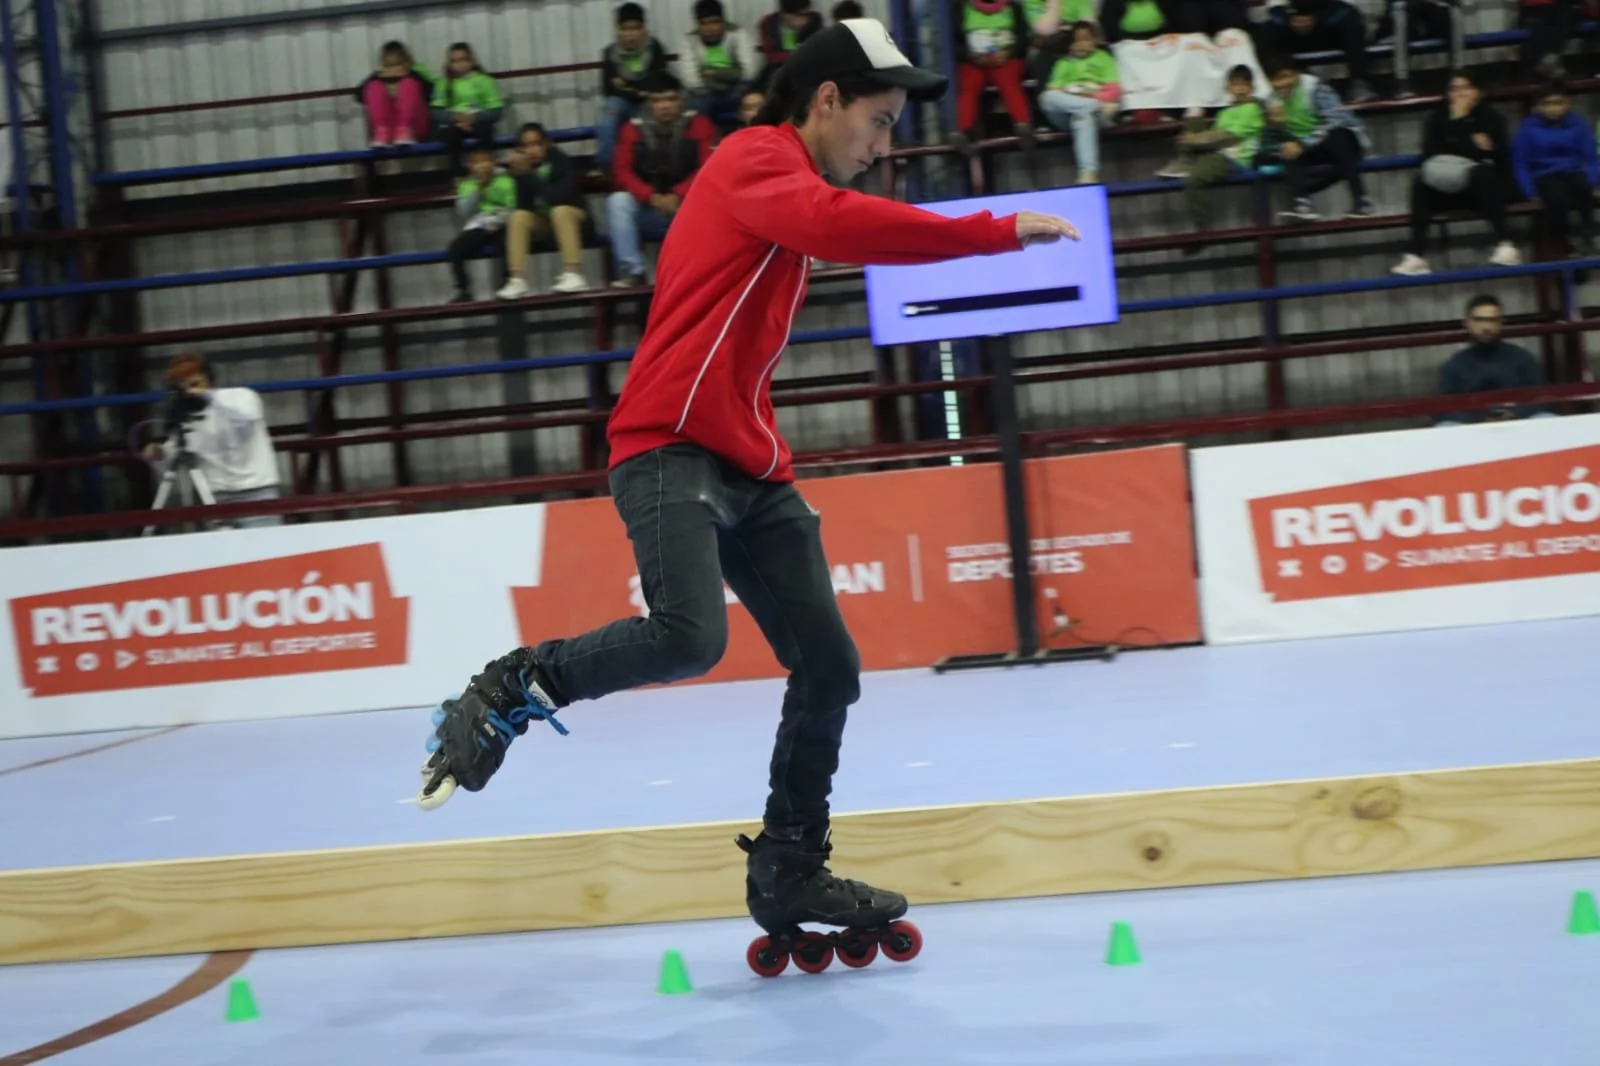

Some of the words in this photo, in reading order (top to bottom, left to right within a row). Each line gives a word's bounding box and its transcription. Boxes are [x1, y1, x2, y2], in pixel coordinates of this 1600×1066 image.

[1270, 466, 1600, 548] REVOLUCIÓ
[947, 551, 1085, 583] DEPOTES
[1396, 542, 1498, 567] SUMATE
[1499, 541, 1535, 559] AL
[1536, 534, 1600, 556] DEPO
[831, 561, 885, 595] AN
[30, 571, 374, 646] REVOLUCIÓN
[145, 642, 237, 666] SUMATE
[237, 641, 269, 657] AL
[270, 632, 376, 656] DEPORTE
